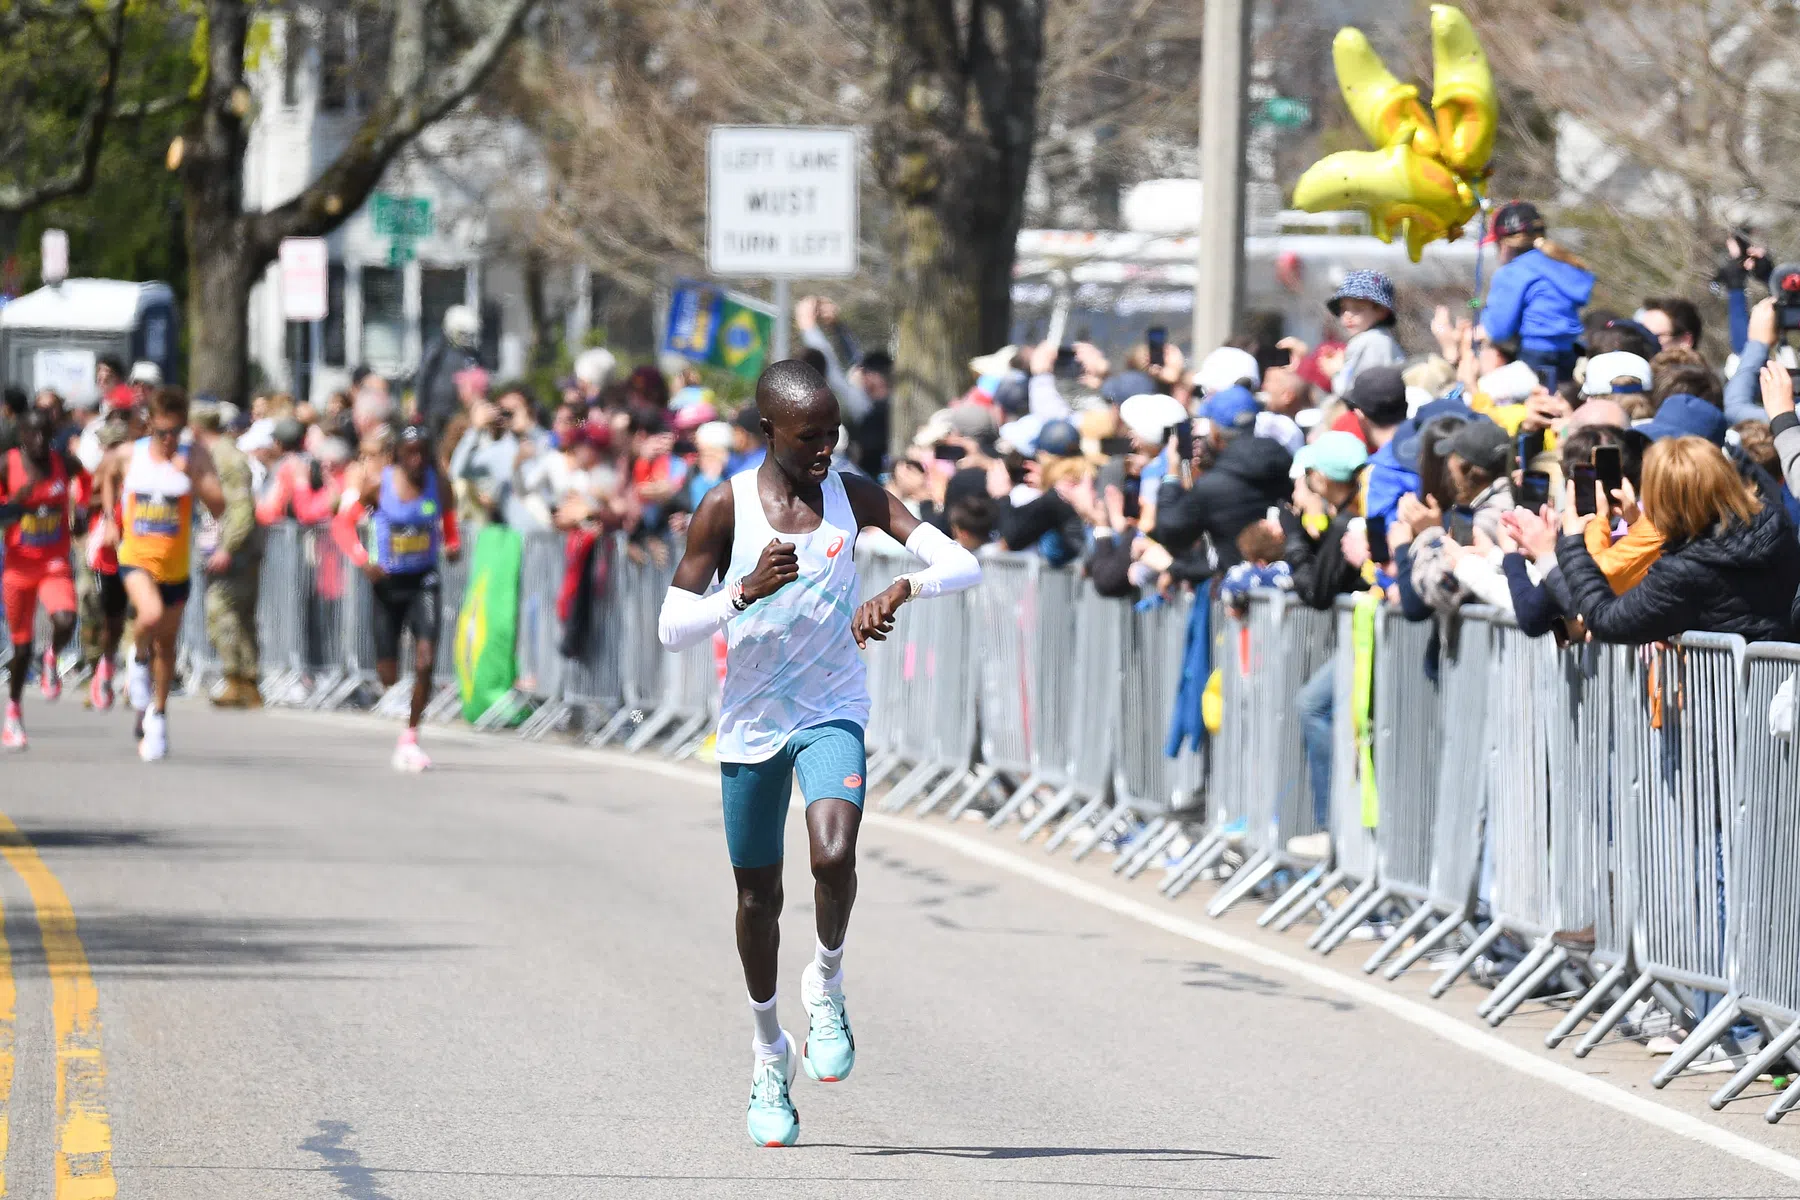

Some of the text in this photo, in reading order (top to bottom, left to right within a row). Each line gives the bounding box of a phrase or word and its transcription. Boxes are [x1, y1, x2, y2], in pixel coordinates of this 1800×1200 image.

[723, 148, 839, 171] LEFT LANE
[747, 188, 817, 216] MUST
[724, 232, 843, 255] TURN LEFT
